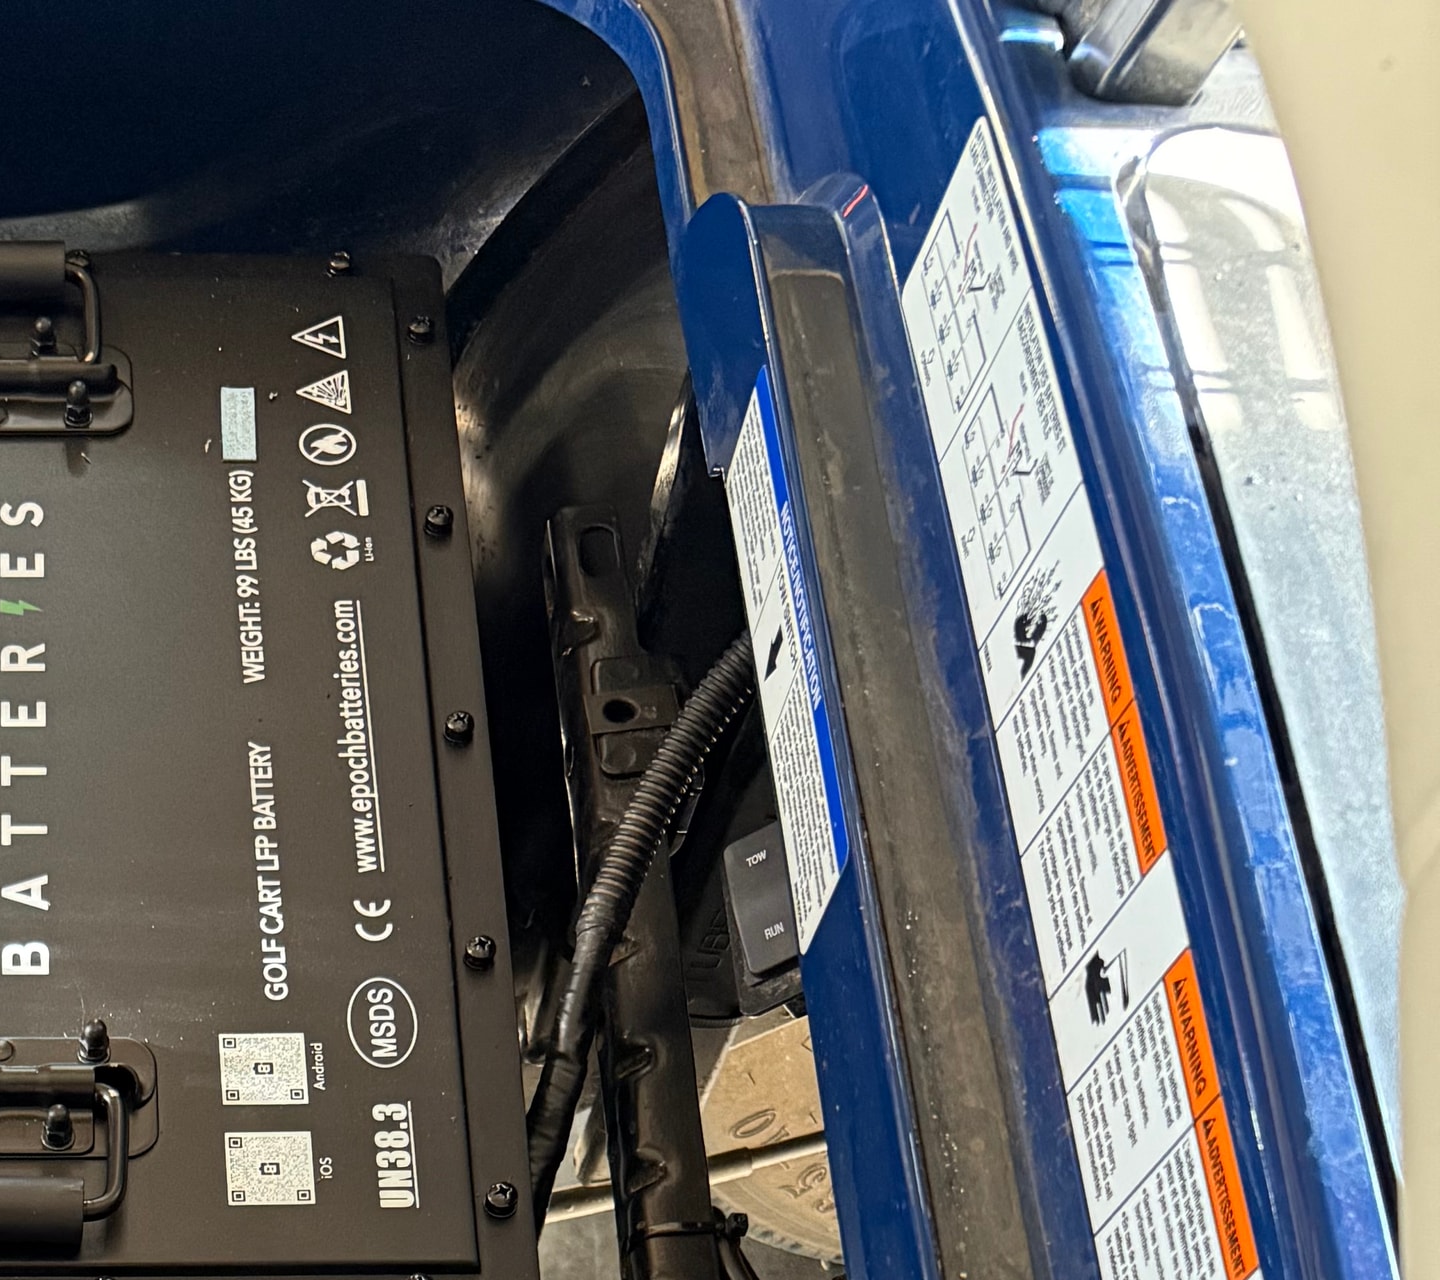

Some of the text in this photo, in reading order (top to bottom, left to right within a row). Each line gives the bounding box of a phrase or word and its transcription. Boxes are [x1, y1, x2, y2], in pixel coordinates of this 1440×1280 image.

[228, 470, 266, 684] WEIGHT: 99 LBS (45 KG)
[780, 495, 821, 715] NOTICE/NOTIFICATION
[1092, 610, 1123, 707] WARNING
[332, 599, 382, 873] www.epochbatteries.com
[1120, 731, 1155, 868] ADVERTISSEMENT
[247, 741, 289, 1001] GOLF CART LFP BATTERY
[746, 849, 767, 867] TOW
[764, 921, 785, 940] RUN
[312, 1041, 326, 1092] Android
[367, 986, 398, 1058] MSDS
[1176, 990, 1207, 1101] WARNING
[318, 1156, 333, 1180] iOS
[371, 1101, 417, 1209] UN38.3
